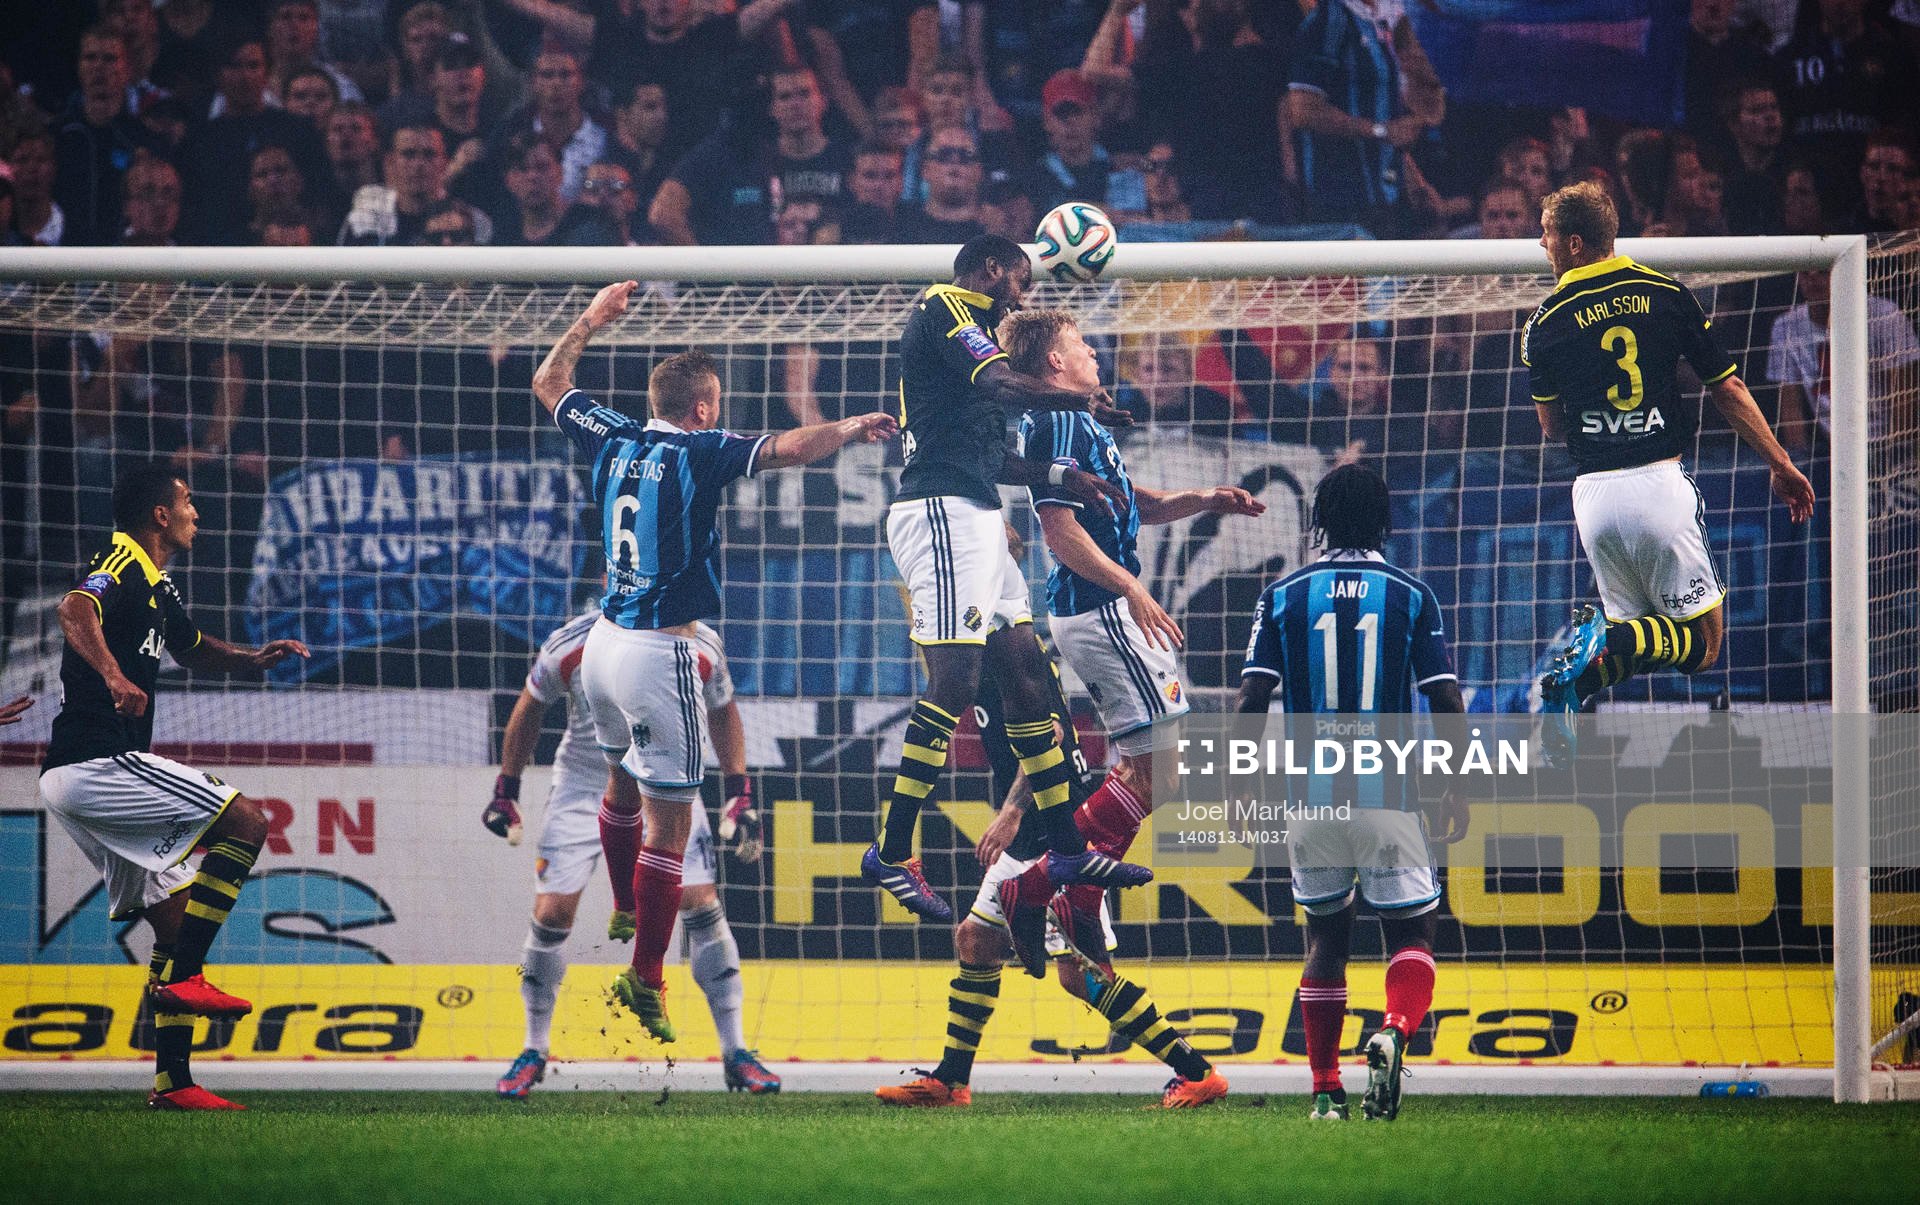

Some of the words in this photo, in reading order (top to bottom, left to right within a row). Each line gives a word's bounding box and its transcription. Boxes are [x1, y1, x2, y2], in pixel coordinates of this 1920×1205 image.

[1574, 295, 1650, 329] KARLSSON
[1600, 325, 1644, 411] 3
[566, 408, 608, 436] stadium
[1581, 406, 1665, 434] SVEA
[612, 494, 641, 570] 6
[1326, 580, 1369, 598] JAWO
[1661, 586, 1706, 609] Fabege
[1313, 612, 1379, 711] 11
[1315, 719, 1376, 737] Prioritet
